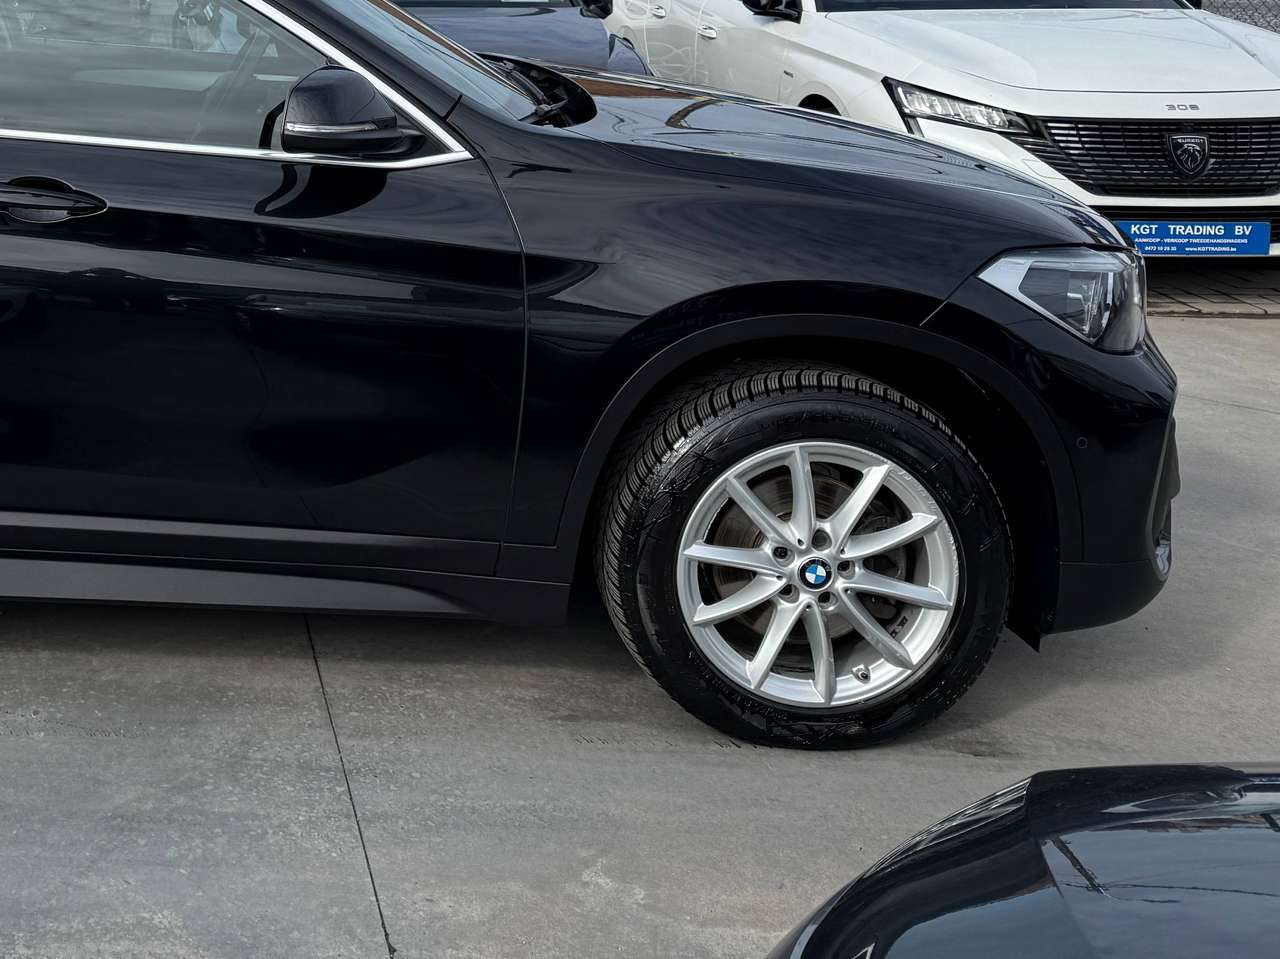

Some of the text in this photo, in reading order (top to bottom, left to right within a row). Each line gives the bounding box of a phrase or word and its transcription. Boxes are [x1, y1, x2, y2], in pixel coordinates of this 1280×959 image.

[1130, 224, 1252, 236] KGT TRADING BV
